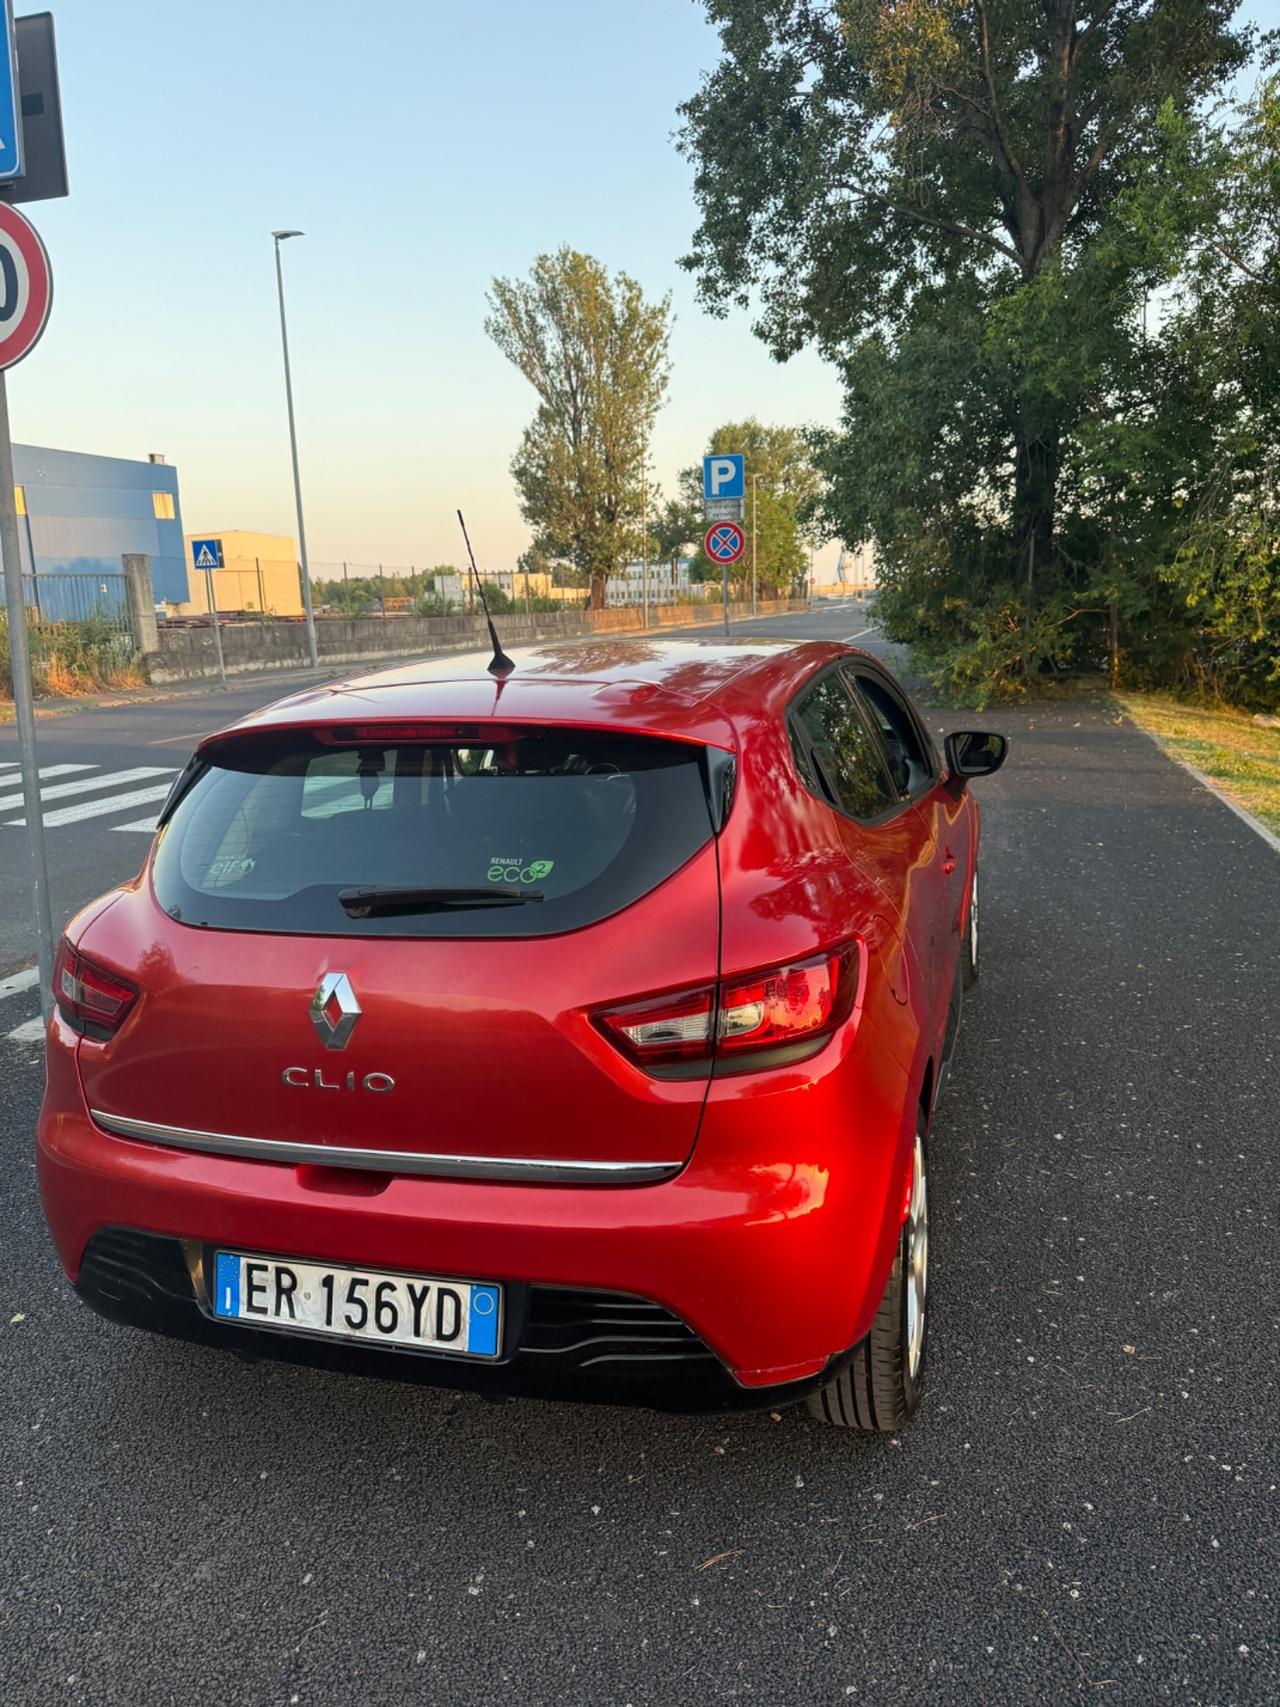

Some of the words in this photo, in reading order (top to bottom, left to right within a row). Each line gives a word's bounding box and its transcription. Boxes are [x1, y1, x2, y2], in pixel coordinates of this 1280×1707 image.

[711, 460, 736, 495] P
[282, 1066, 395, 1093] CLIO
[225, 1287, 232, 1310] I
[246, 1262, 298, 1319] ER
[321, 1273, 462, 1342] 156YD
